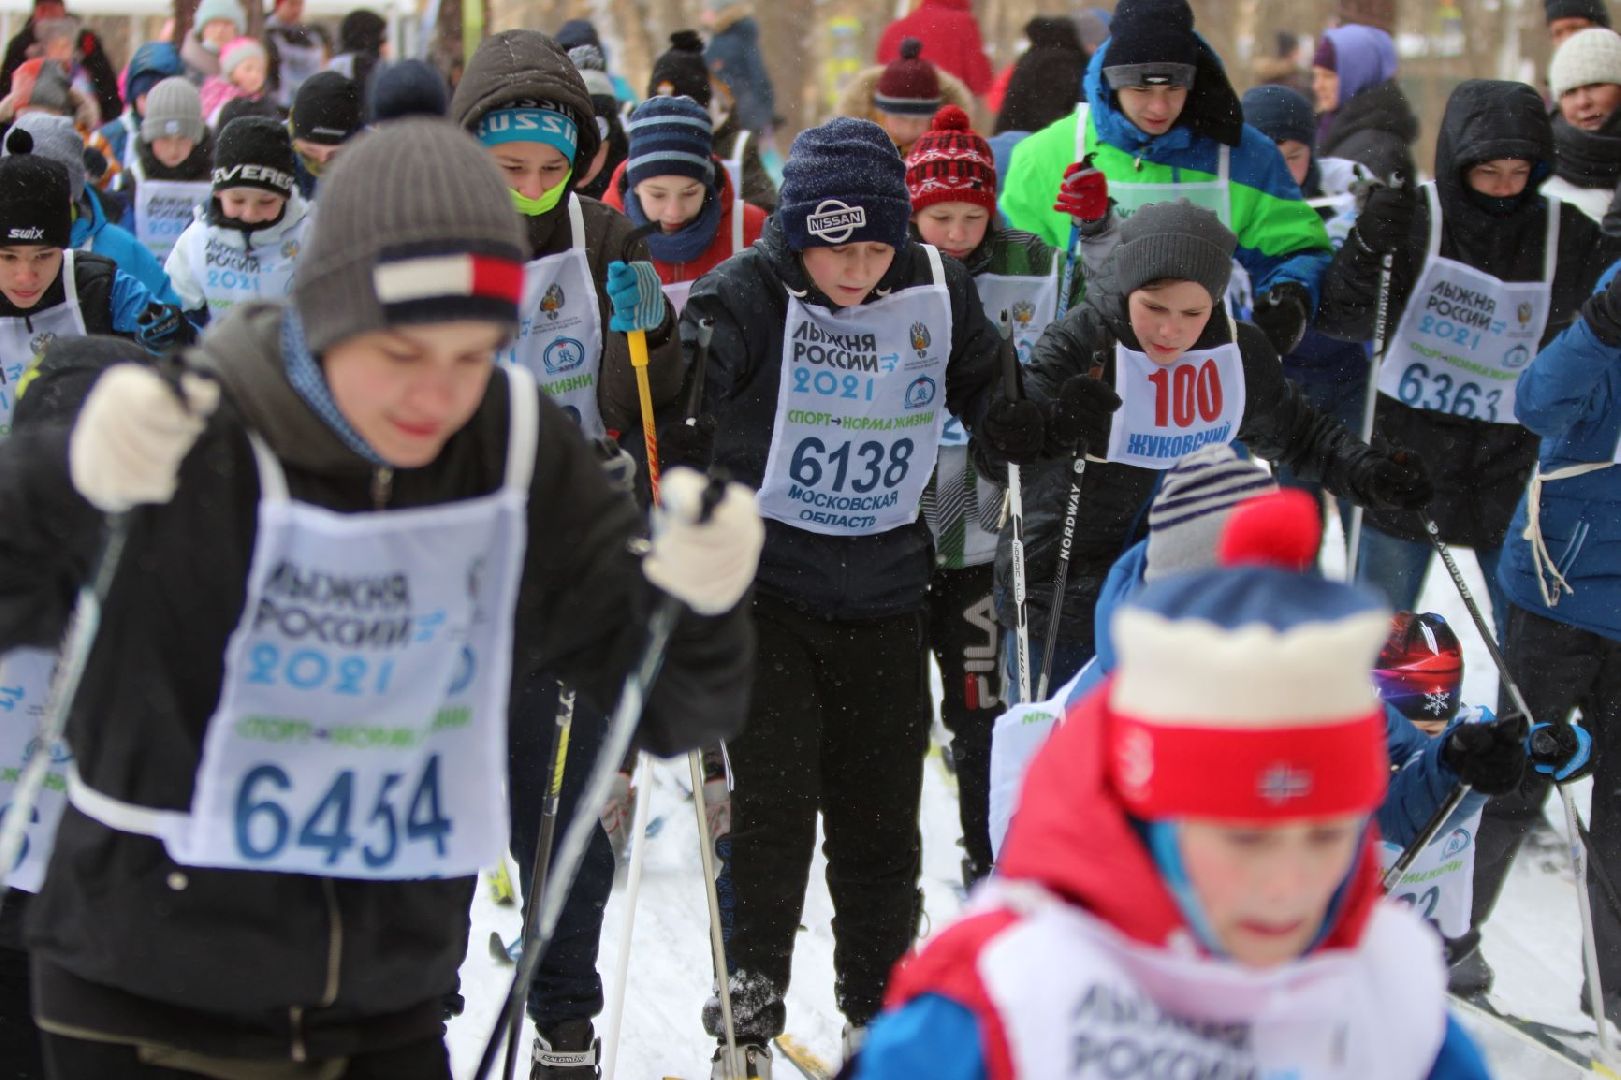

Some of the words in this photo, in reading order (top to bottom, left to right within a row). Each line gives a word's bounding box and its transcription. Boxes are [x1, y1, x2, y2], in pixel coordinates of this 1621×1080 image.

[811, 211, 861, 231] NISSAN
[1426, 295, 1492, 331] РОССИИ
[1431, 280, 1496, 314] ЛЫЖНЯ
[793, 320, 877, 352] ЛЫЖНЯ
[1418, 315, 1482, 350] 2021
[793, 342, 879, 373] РОССИИ
[793, 366, 874, 401] 2021
[1147, 358, 1224, 428] 100
[787, 409, 832, 427] СПОРТ
[842, 416, 893, 431] НОРМА
[894, 410, 935, 430] ЖИЗНИ
[1127, 421, 1231, 458] ЖУКОВСКИЙ
[789, 436, 915, 494] 6138
[788, 484, 899, 511] МОСКОВСКАЯ
[799, 509, 877, 528] ОБЛАСТЬ
[1060, 484, 1082, 561] NORDWAY
[1437, 541, 1472, 599] NORDWAY
[254, 597, 411, 648] РОССИИ
[245, 641, 395, 695] 2021
[963, 595, 998, 710] FILA
[234, 753, 454, 868] 6454
